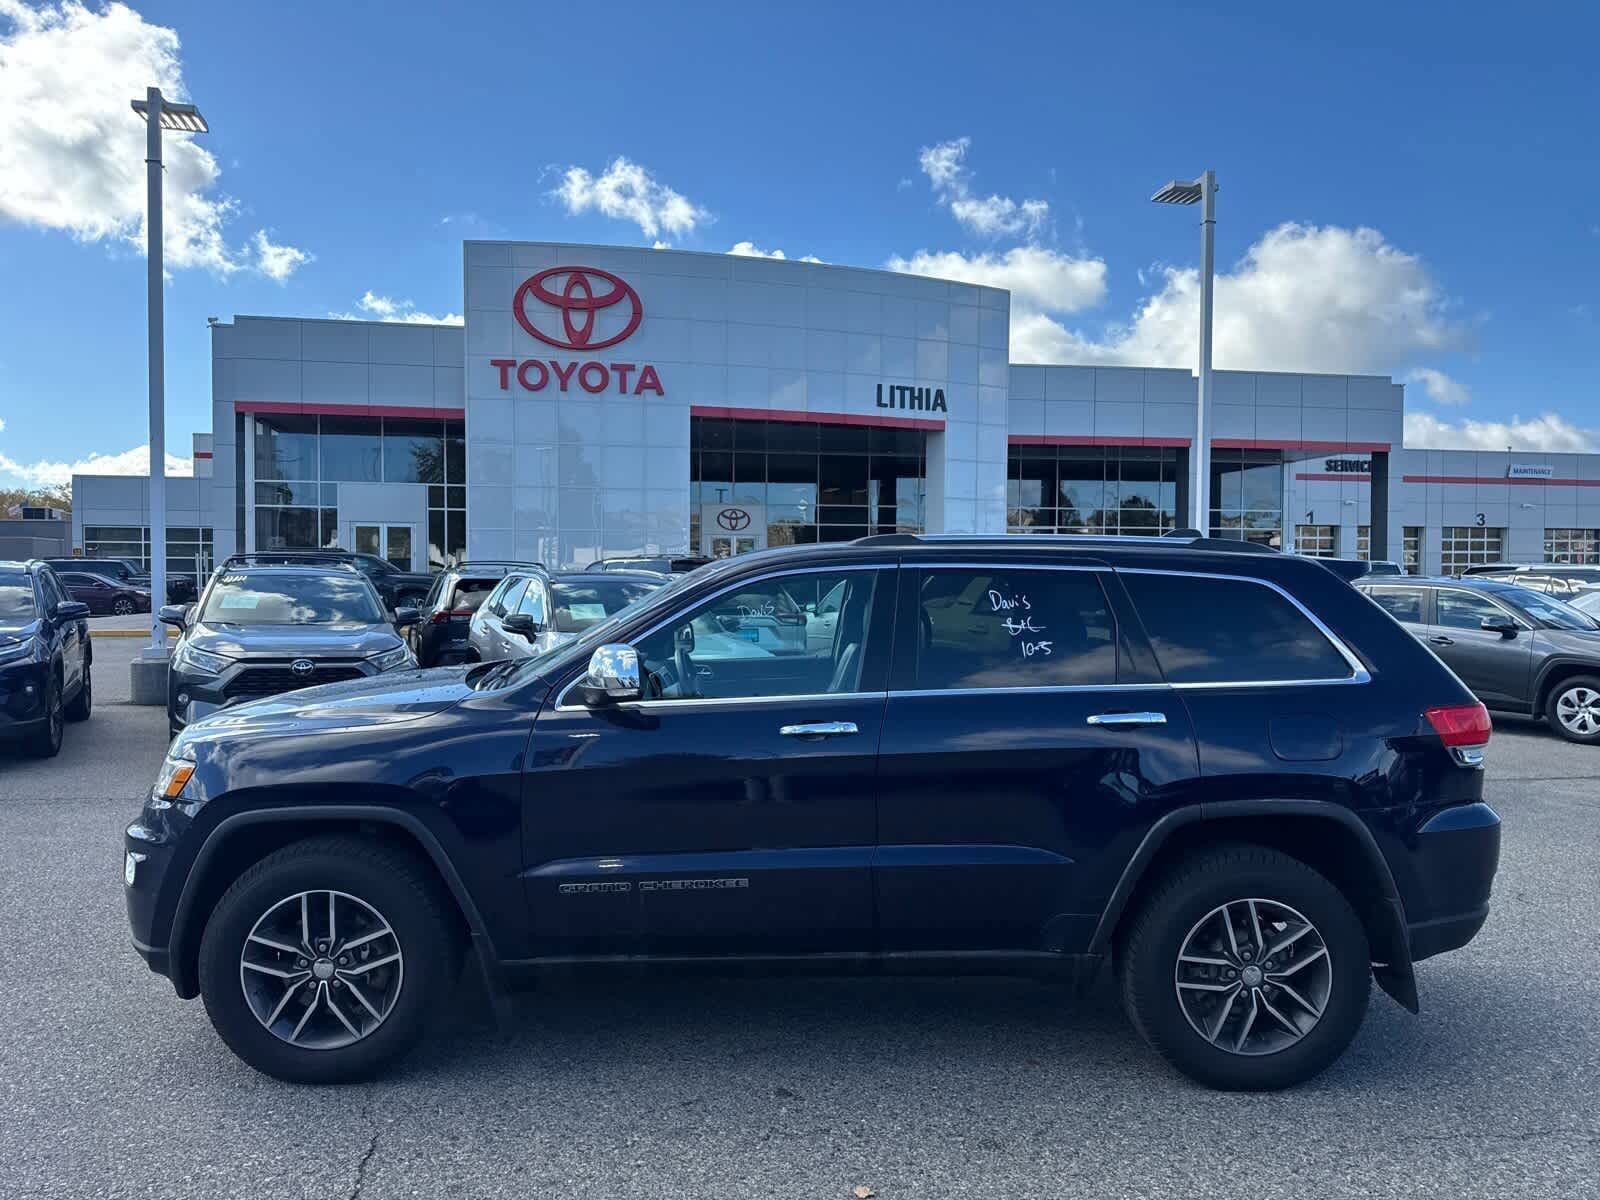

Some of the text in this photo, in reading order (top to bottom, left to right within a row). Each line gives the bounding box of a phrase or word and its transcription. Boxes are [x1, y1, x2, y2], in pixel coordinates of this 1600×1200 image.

[490, 359, 664, 396] TOYOTA
[877, 383, 947, 412] LITHIA
[1325, 459, 1372, 473] SERVIC
[1512, 467, 1552, 476] MAINTENANCE
[1306, 510, 1314, 524] 1
[1475, 512, 1486, 527] 3
[988, 589, 1032, 612] Davis
[559, 878, 750, 894] GRAND CHEROKEE
